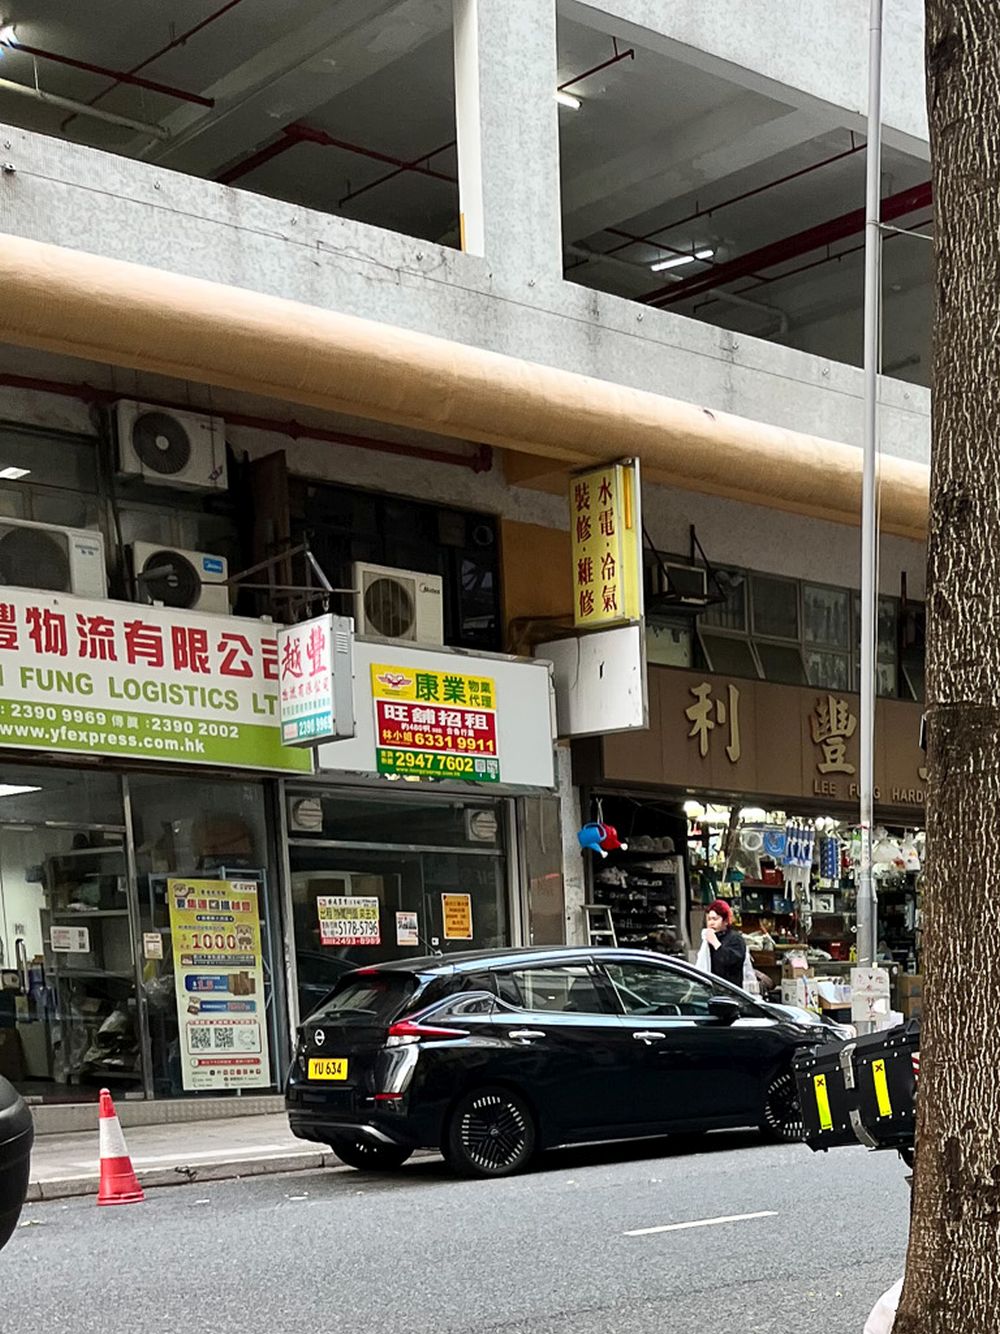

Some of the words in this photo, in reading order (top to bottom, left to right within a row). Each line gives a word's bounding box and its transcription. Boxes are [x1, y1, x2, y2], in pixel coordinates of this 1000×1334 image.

[20, 667, 94, 695] FUNG
[109, 677, 239, 711] LOGISTICS
[252, 693, 278, 715] LT
[415, 673, 466, 704] 康業
[11, 704, 56, 721] 2390
[62, 708, 106, 726] 9969
[199, 722, 239, 738] 2002
[0, 722, 205, 753] www.yfexpress.com.hk
[415, 733, 453, 748] 6331
[457, 736, 494, 752] 9911
[395, 752, 434, 768] 2947
[437, 755, 474, 772] 7602
[813, 778, 836, 796] LEE
[849, 783, 881, 800] FUG
[892, 787, 929, 804] HARD
[191, 933, 236, 950] 1000
[313, 1063, 324, 1075] YU
[325, 1062, 342, 1075] 634
